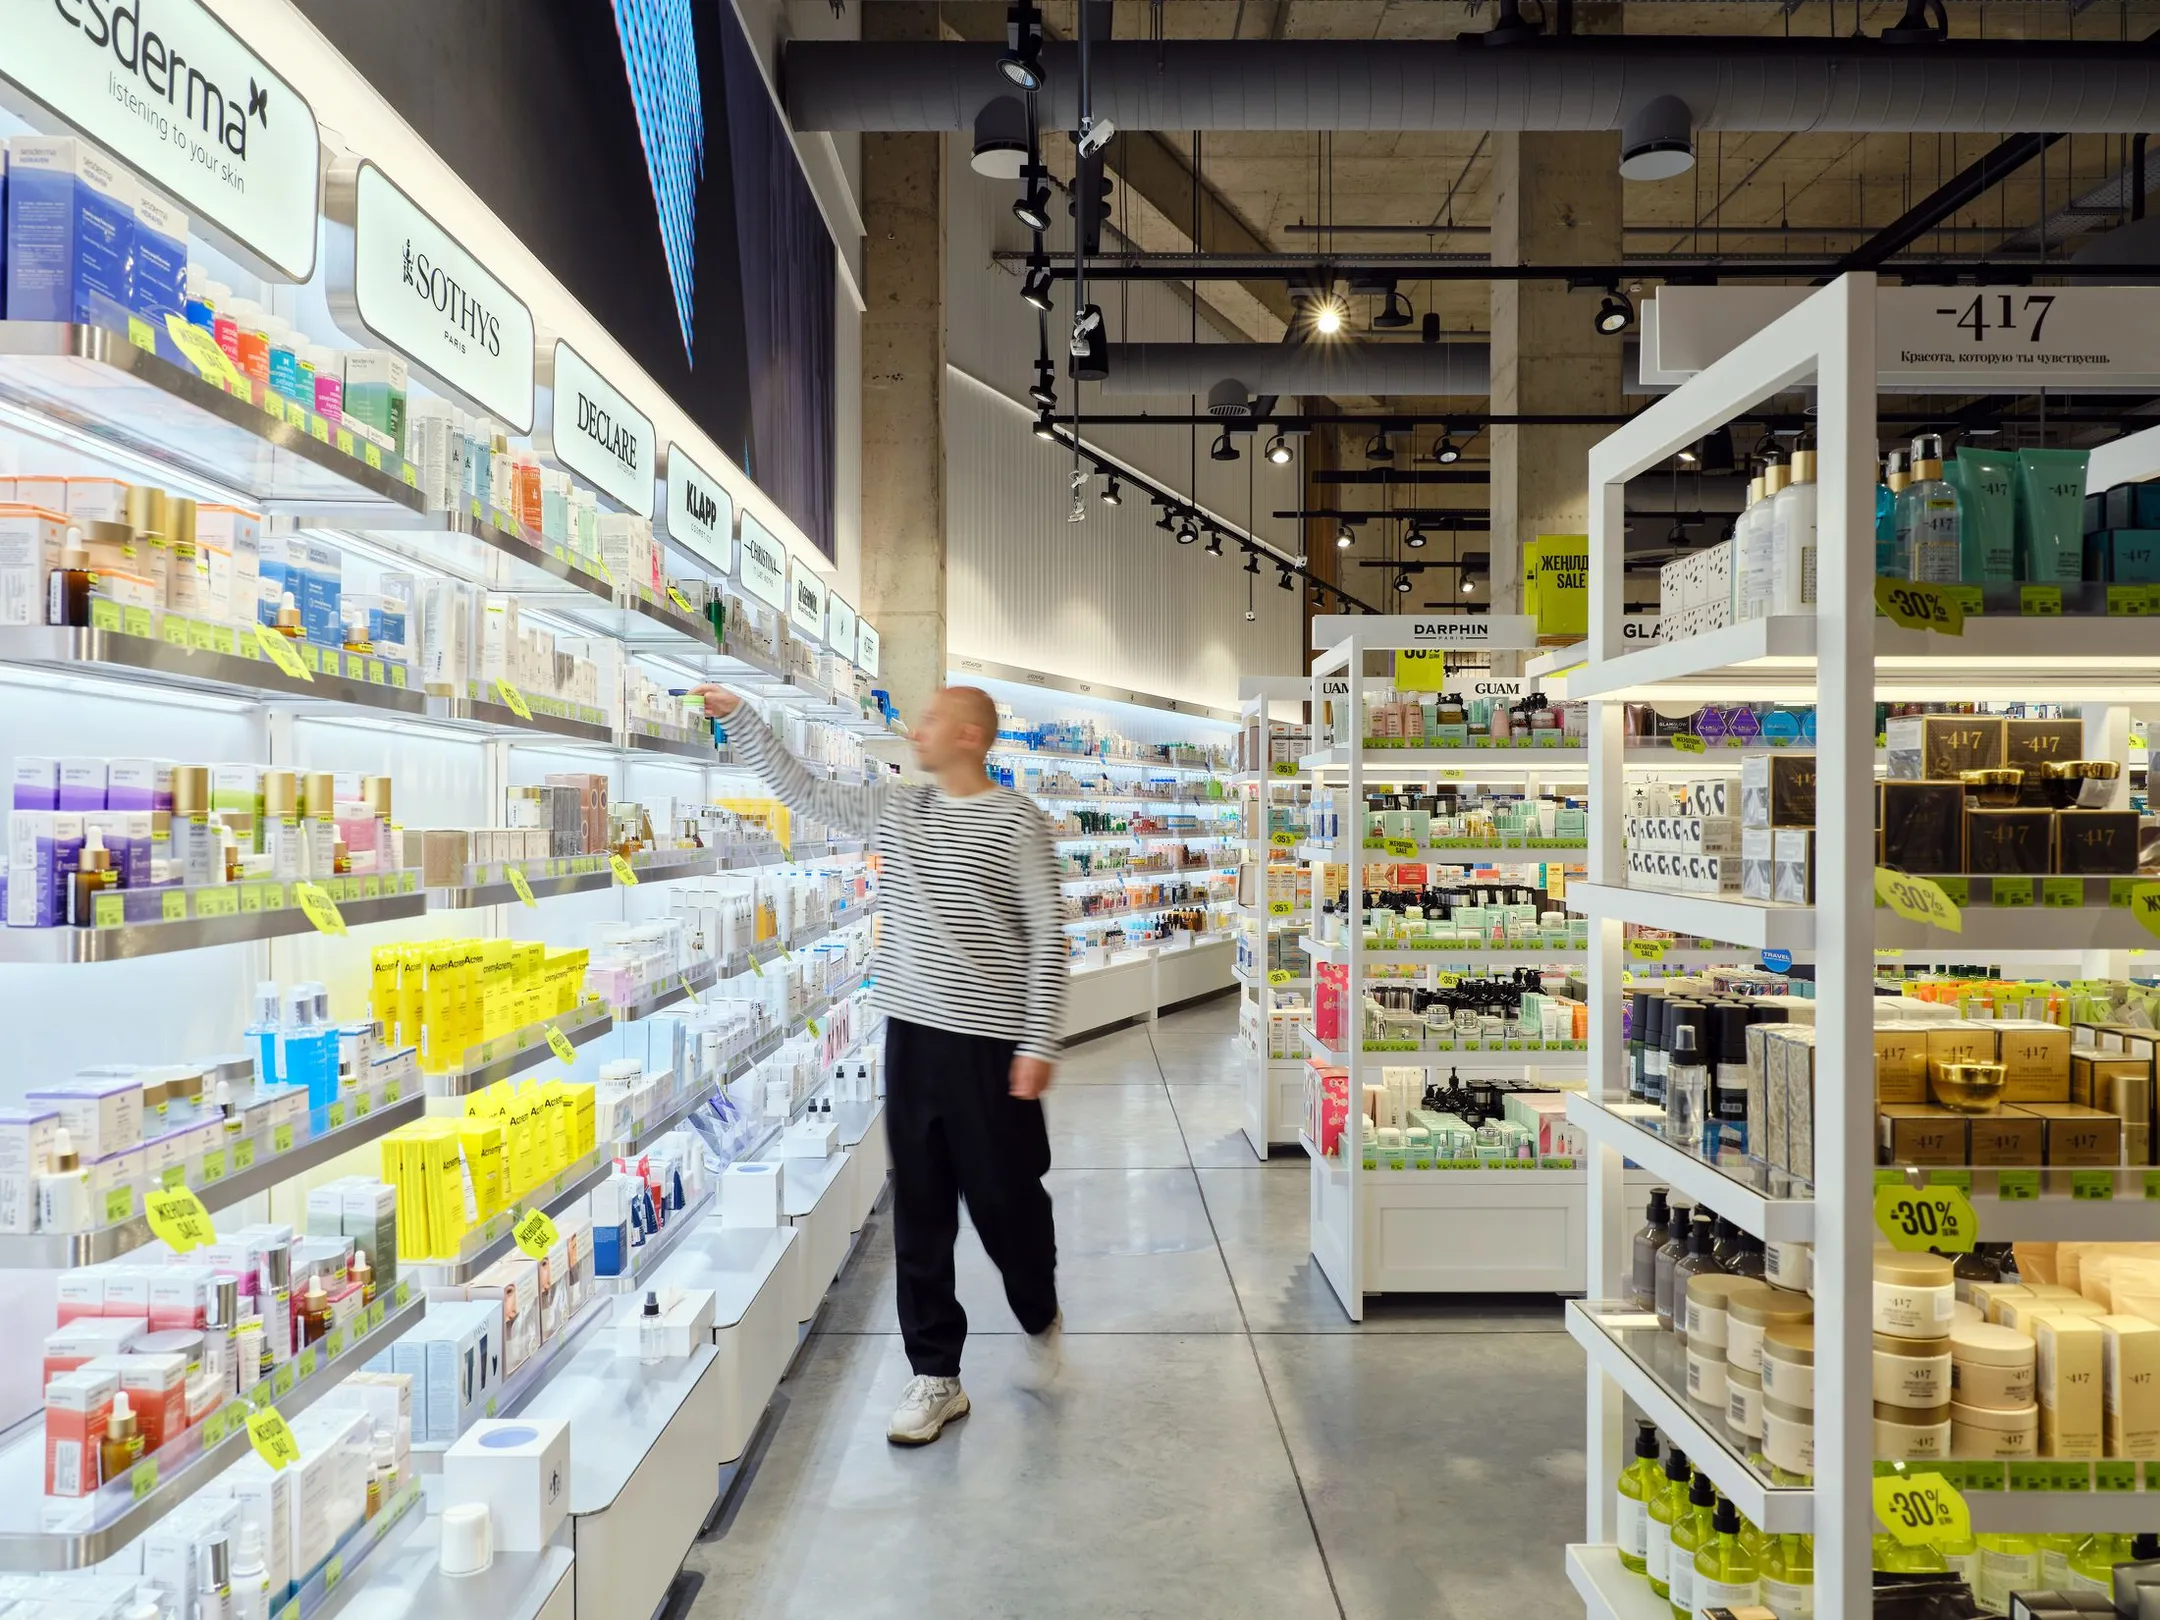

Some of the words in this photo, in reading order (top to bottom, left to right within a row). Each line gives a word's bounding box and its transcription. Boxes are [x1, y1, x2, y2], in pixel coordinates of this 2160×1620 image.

[108, 71, 168, 141] listening
[173, 123, 187, 149] to
[190, 140, 219, 174] your
[221, 162, 245, 194] skin
[416, 253, 500, 357] SOTHYS
[1936, 294, 2056, 342] -417
[444, 330, 466, 355] PARIS
[1900, 350, 1954, 365] Красота,
[1959, 353, 2013, 366] которую
[2015, 354, 2034, 365] ты
[2038, 353, 2111, 366] чувствуешь
[577, 392, 637, 470] DECLARE
[2048, 484, 2078, 497] -417
[686, 479, 717, 531] KLAPP
[1557, 573, 1586, 588] SALE
[1413, 624, 1489, 636] DARPHIN
[1475, 683, 1520, 694] GUAM
[1939, 731, 1983, 749] -417
[2022, 736, 2060, 752] -417
[1983, 825, 2029, 844] -417
[2077, 829, 2116, 847] -417
[1763, 951, 1790, 960] TRAVEL
[2017, 1046, 2048, 1060] -417
[1912, 1135, 1944, 1149] -417
[2065, 1135, 2097, 1149] -417
[1890, 1200, 1957, 1235] -30%
[533, 1231, 550, 1248] SALE
[1908, 1370, 1932, 1380] -417
[2066, 1373, 2090, 1384] -417
[2129, 1373, 2151, 1384] -417
[1912, 1437, 1935, 1447] -417
[2000, 1435, 2024, 1445] -417
[1889, 1489, 1949, 1527] -30%
